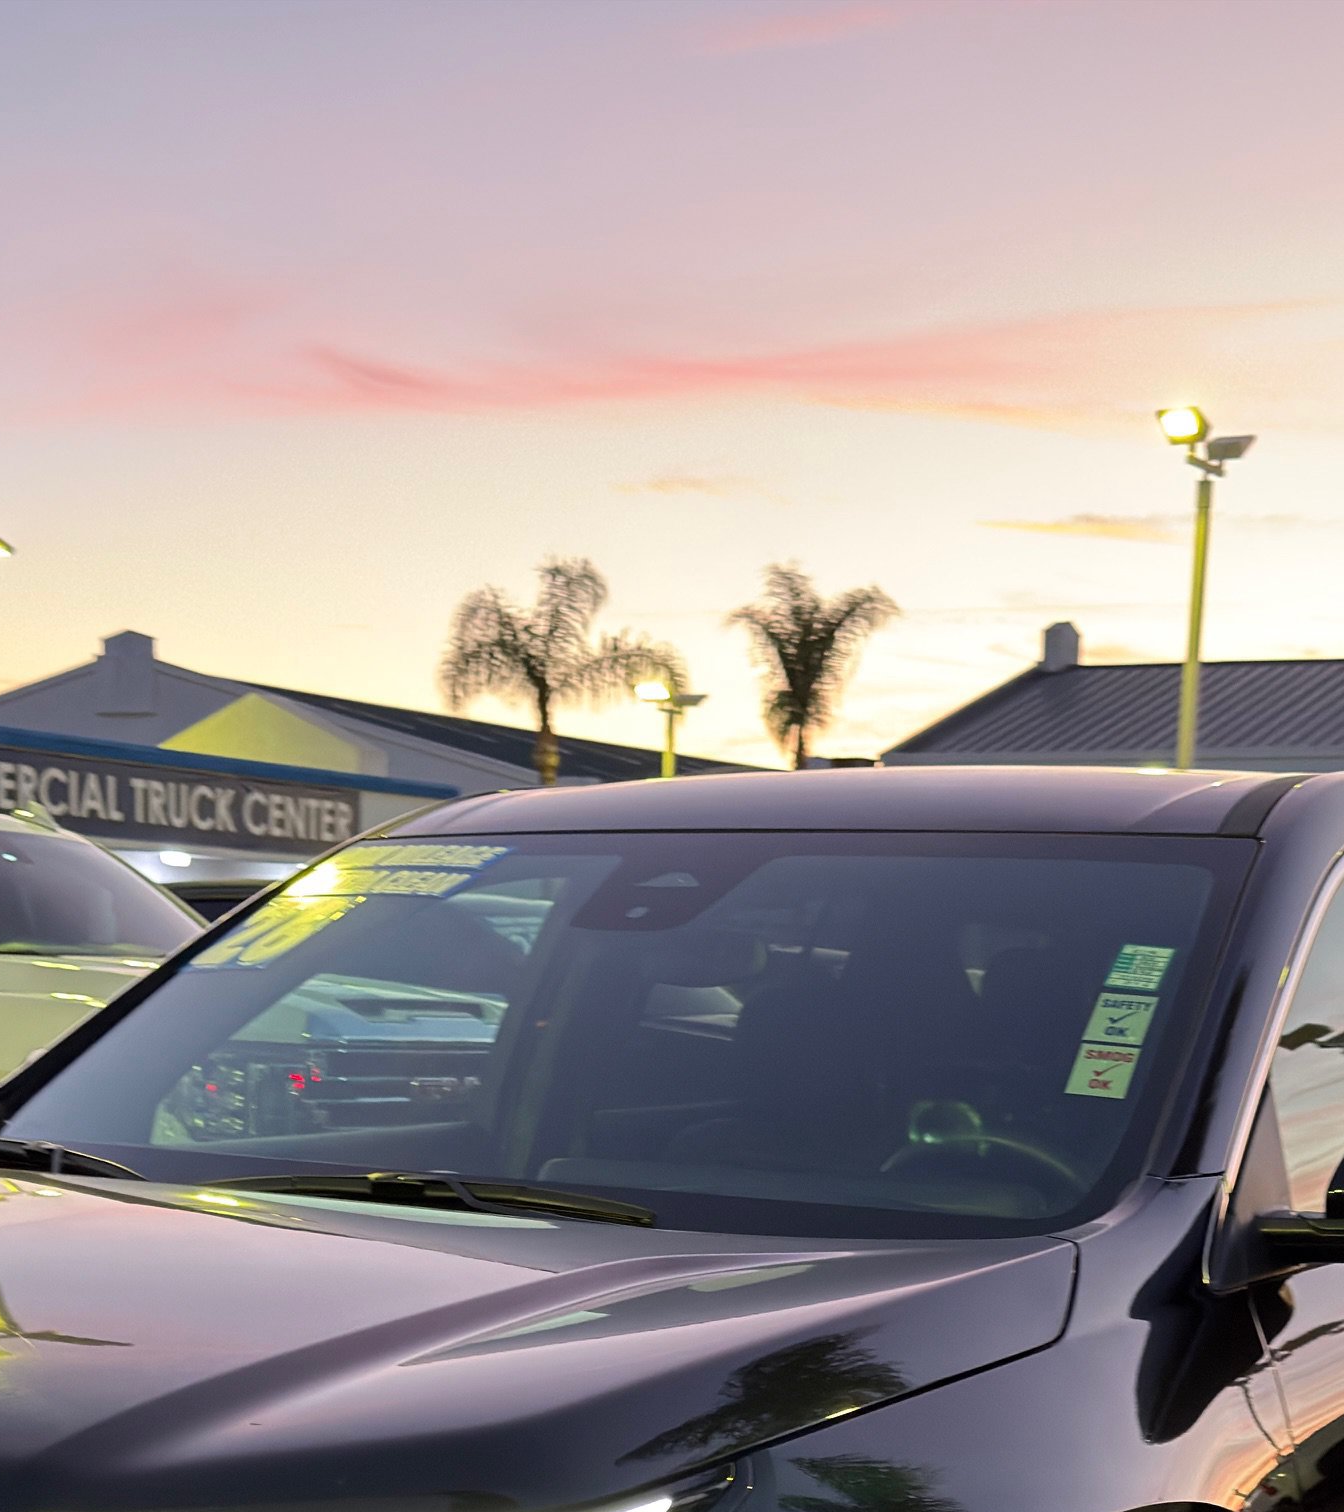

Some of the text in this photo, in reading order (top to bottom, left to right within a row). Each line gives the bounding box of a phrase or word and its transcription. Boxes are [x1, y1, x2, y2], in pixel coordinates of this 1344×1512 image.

[130, 778, 237, 833] TRUCK
[242, 792, 354, 842] CENTER
[1100, 998, 1153, 1013] SAFETY
[1104, 1025, 1130, 1037] OK
[1087, 1078, 1114, 1091] OK
